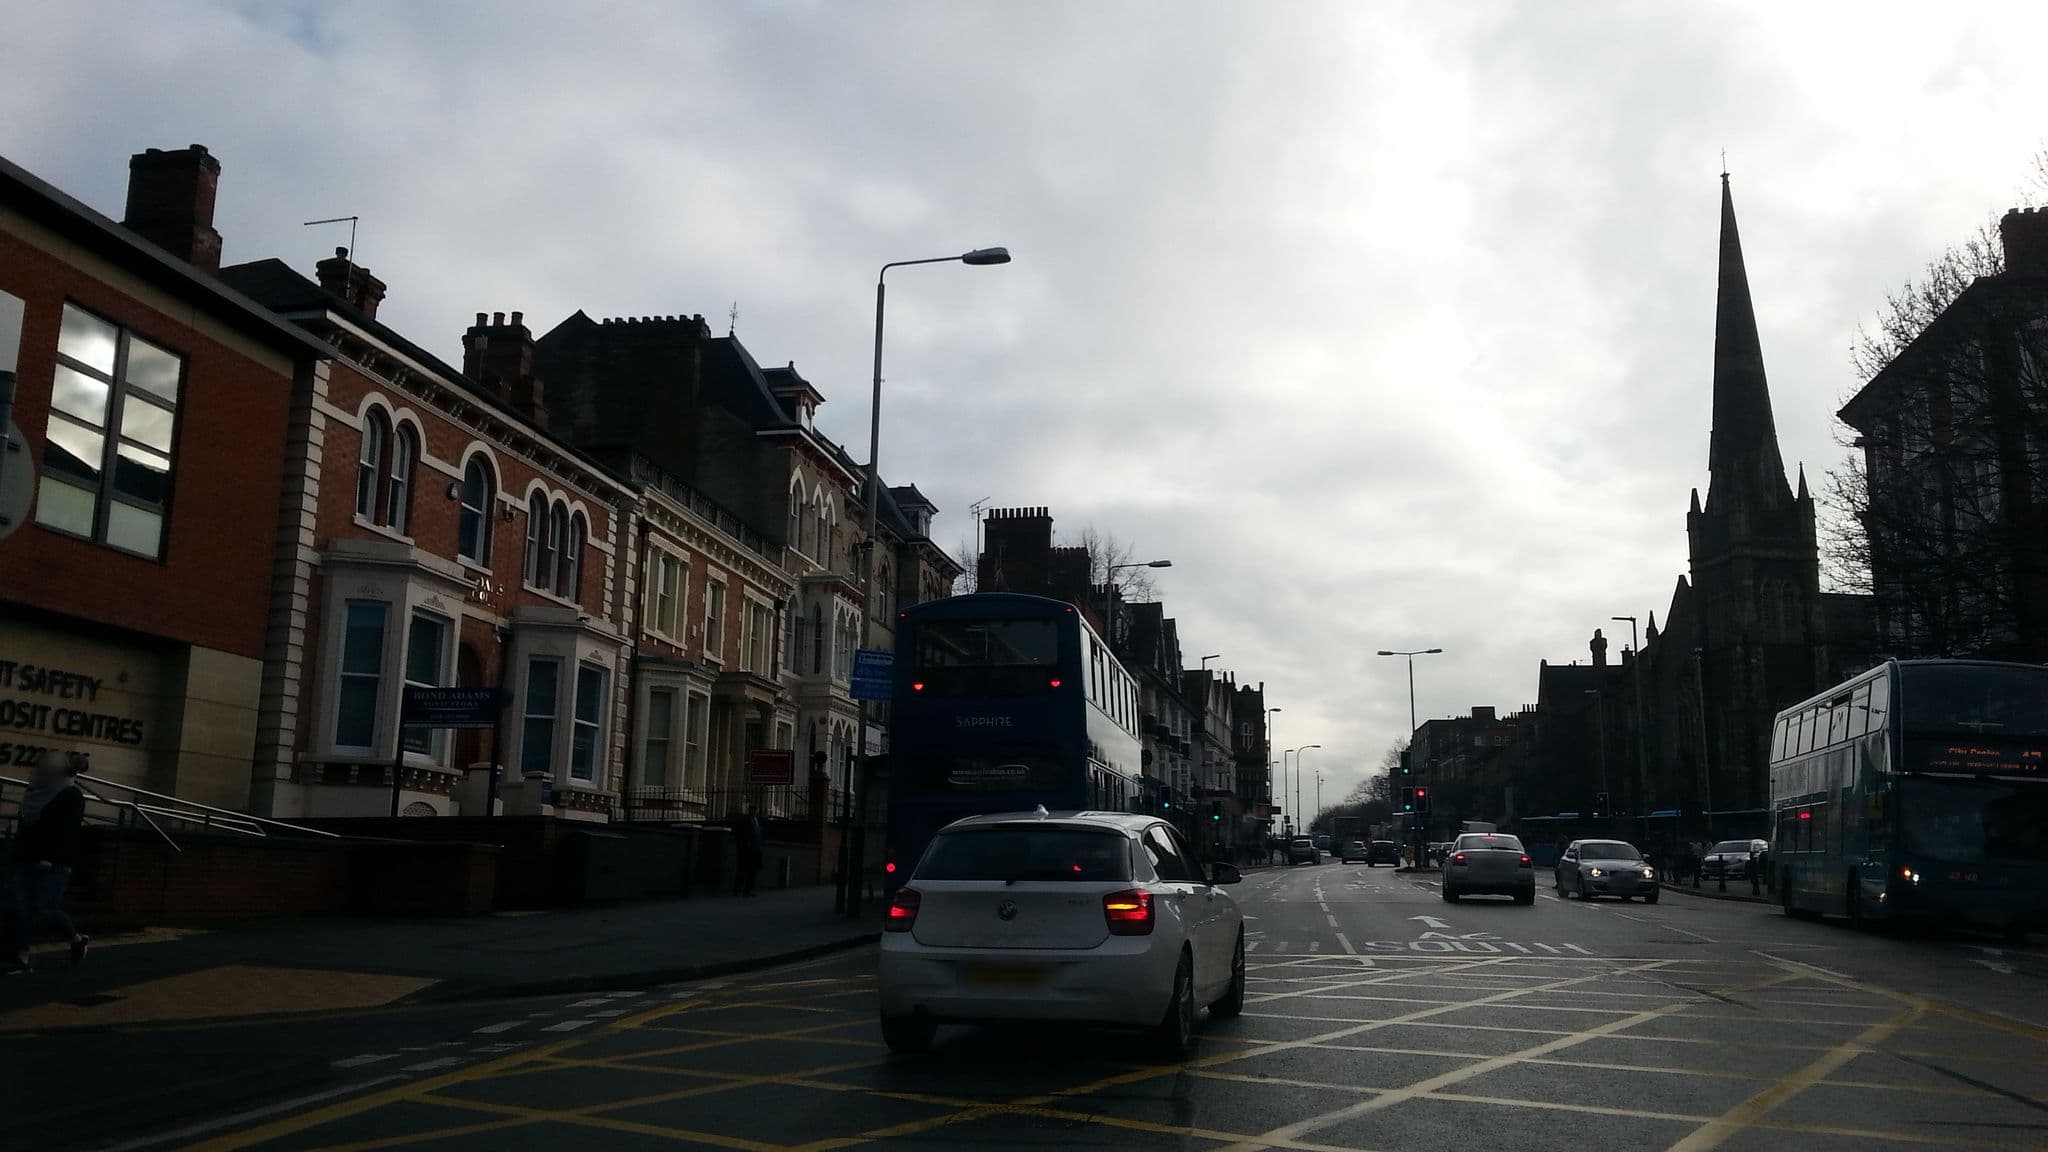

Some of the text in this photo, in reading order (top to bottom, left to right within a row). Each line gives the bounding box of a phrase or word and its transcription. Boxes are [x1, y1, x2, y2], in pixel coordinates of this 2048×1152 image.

[19, 665, 103, 700] SAFETY
[448, 690, 491, 701] ADAMS
[0, 700, 144, 744] OSIT CENTRES
[954, 714, 1014, 728] SAPPHIRE
[1364, 941, 1597, 955] SOUTH
